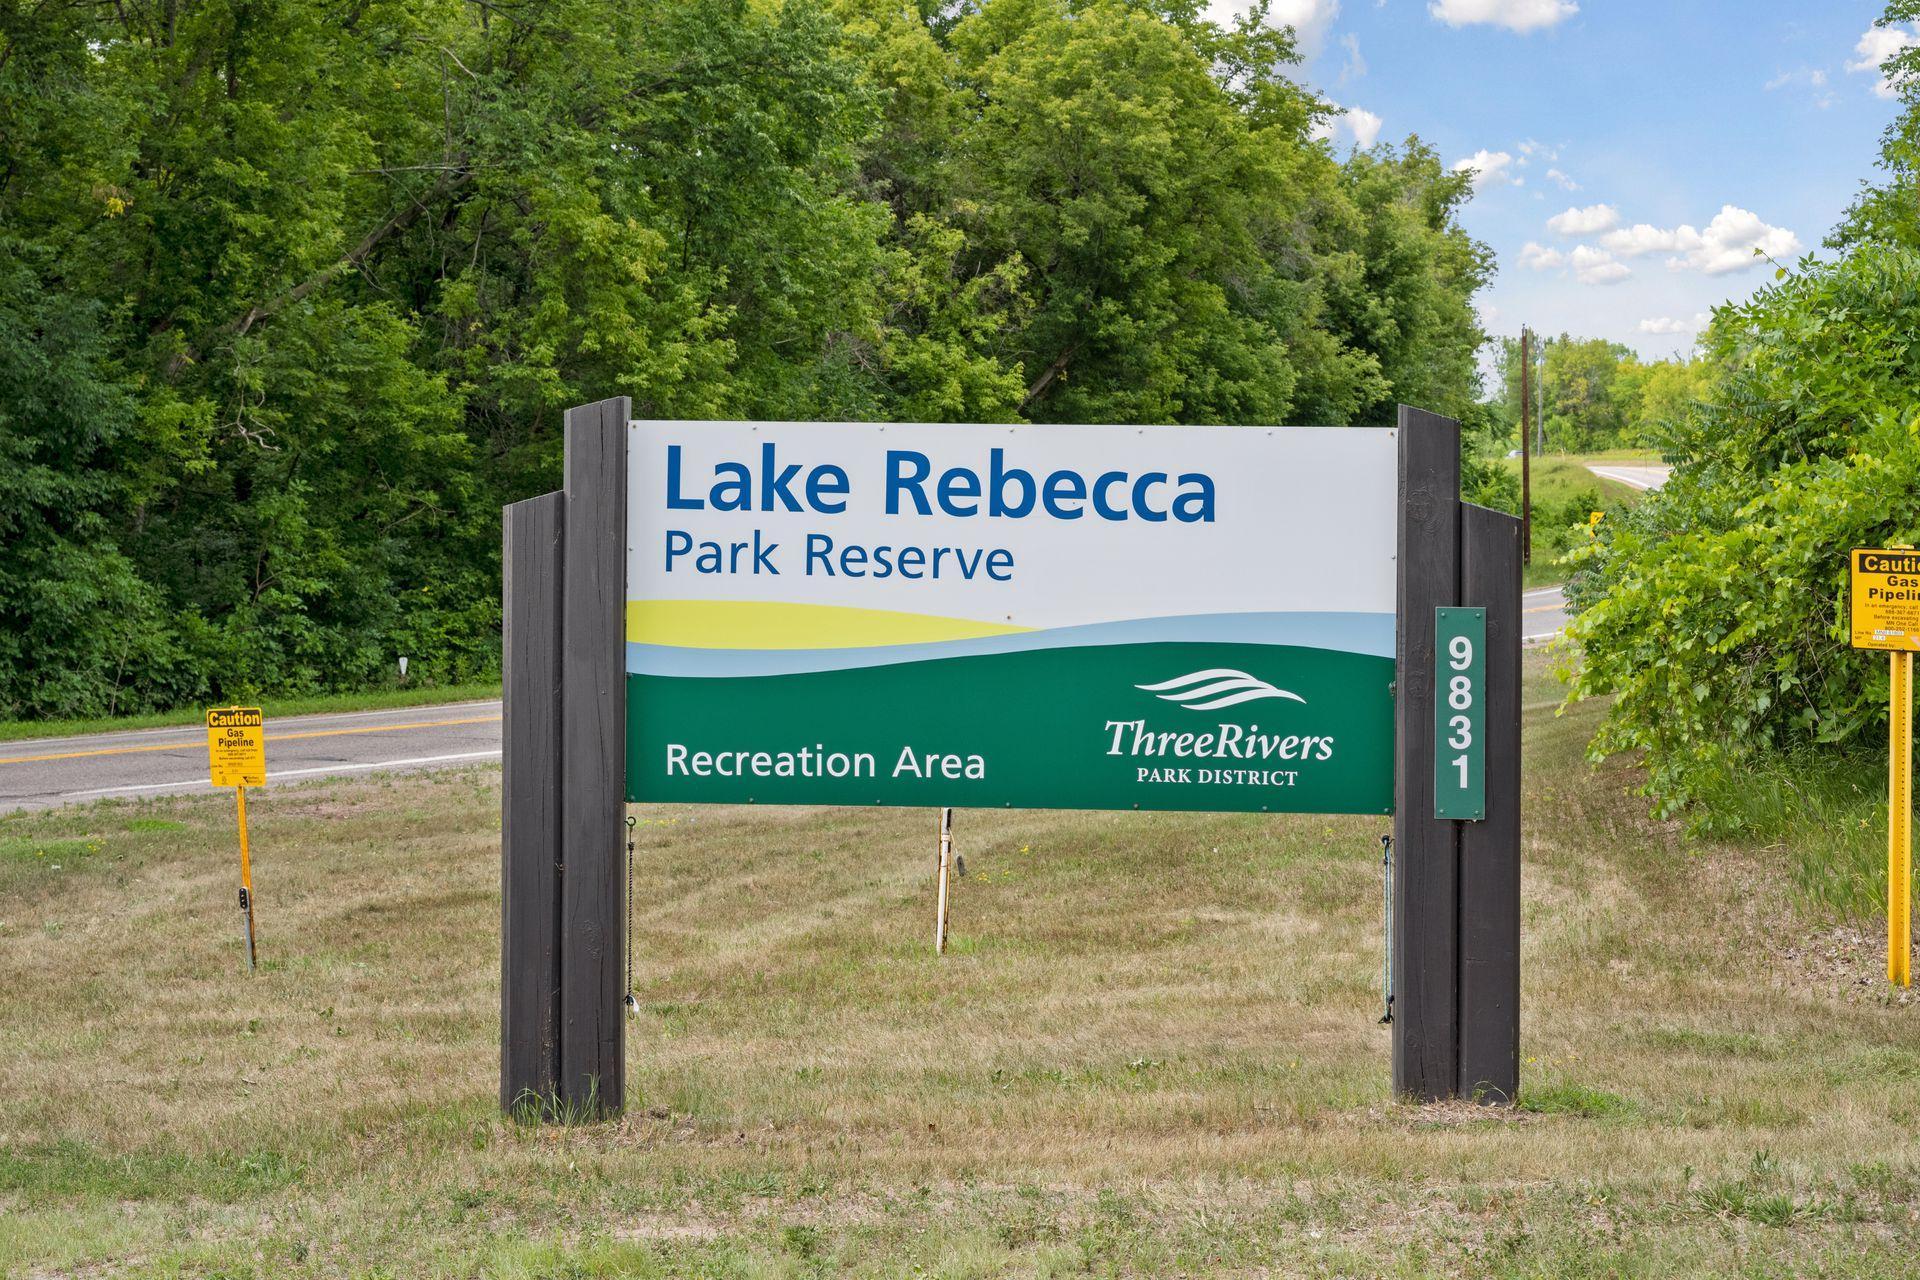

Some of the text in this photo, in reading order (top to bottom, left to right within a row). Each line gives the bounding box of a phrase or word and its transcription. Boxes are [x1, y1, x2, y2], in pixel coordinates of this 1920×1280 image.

[667, 443, 1215, 522] Lake Rebecca
[666, 530, 1014, 581] Park Reserve
[1865, 556, 1920, 572] Cauti
[1887, 576, 1918, 587] Gas
[209, 712, 261, 726] Caution
[1448, 636, 1473, 789] 9831
[227, 729, 244, 738] Gas
[1105, 720, 1333, 762] ThreeRivers
[218, 738, 254, 748] Pipeline
[667, 743, 985, 779] Recreation Area
[1137, 768, 1298, 786] PARK DISTRICT
